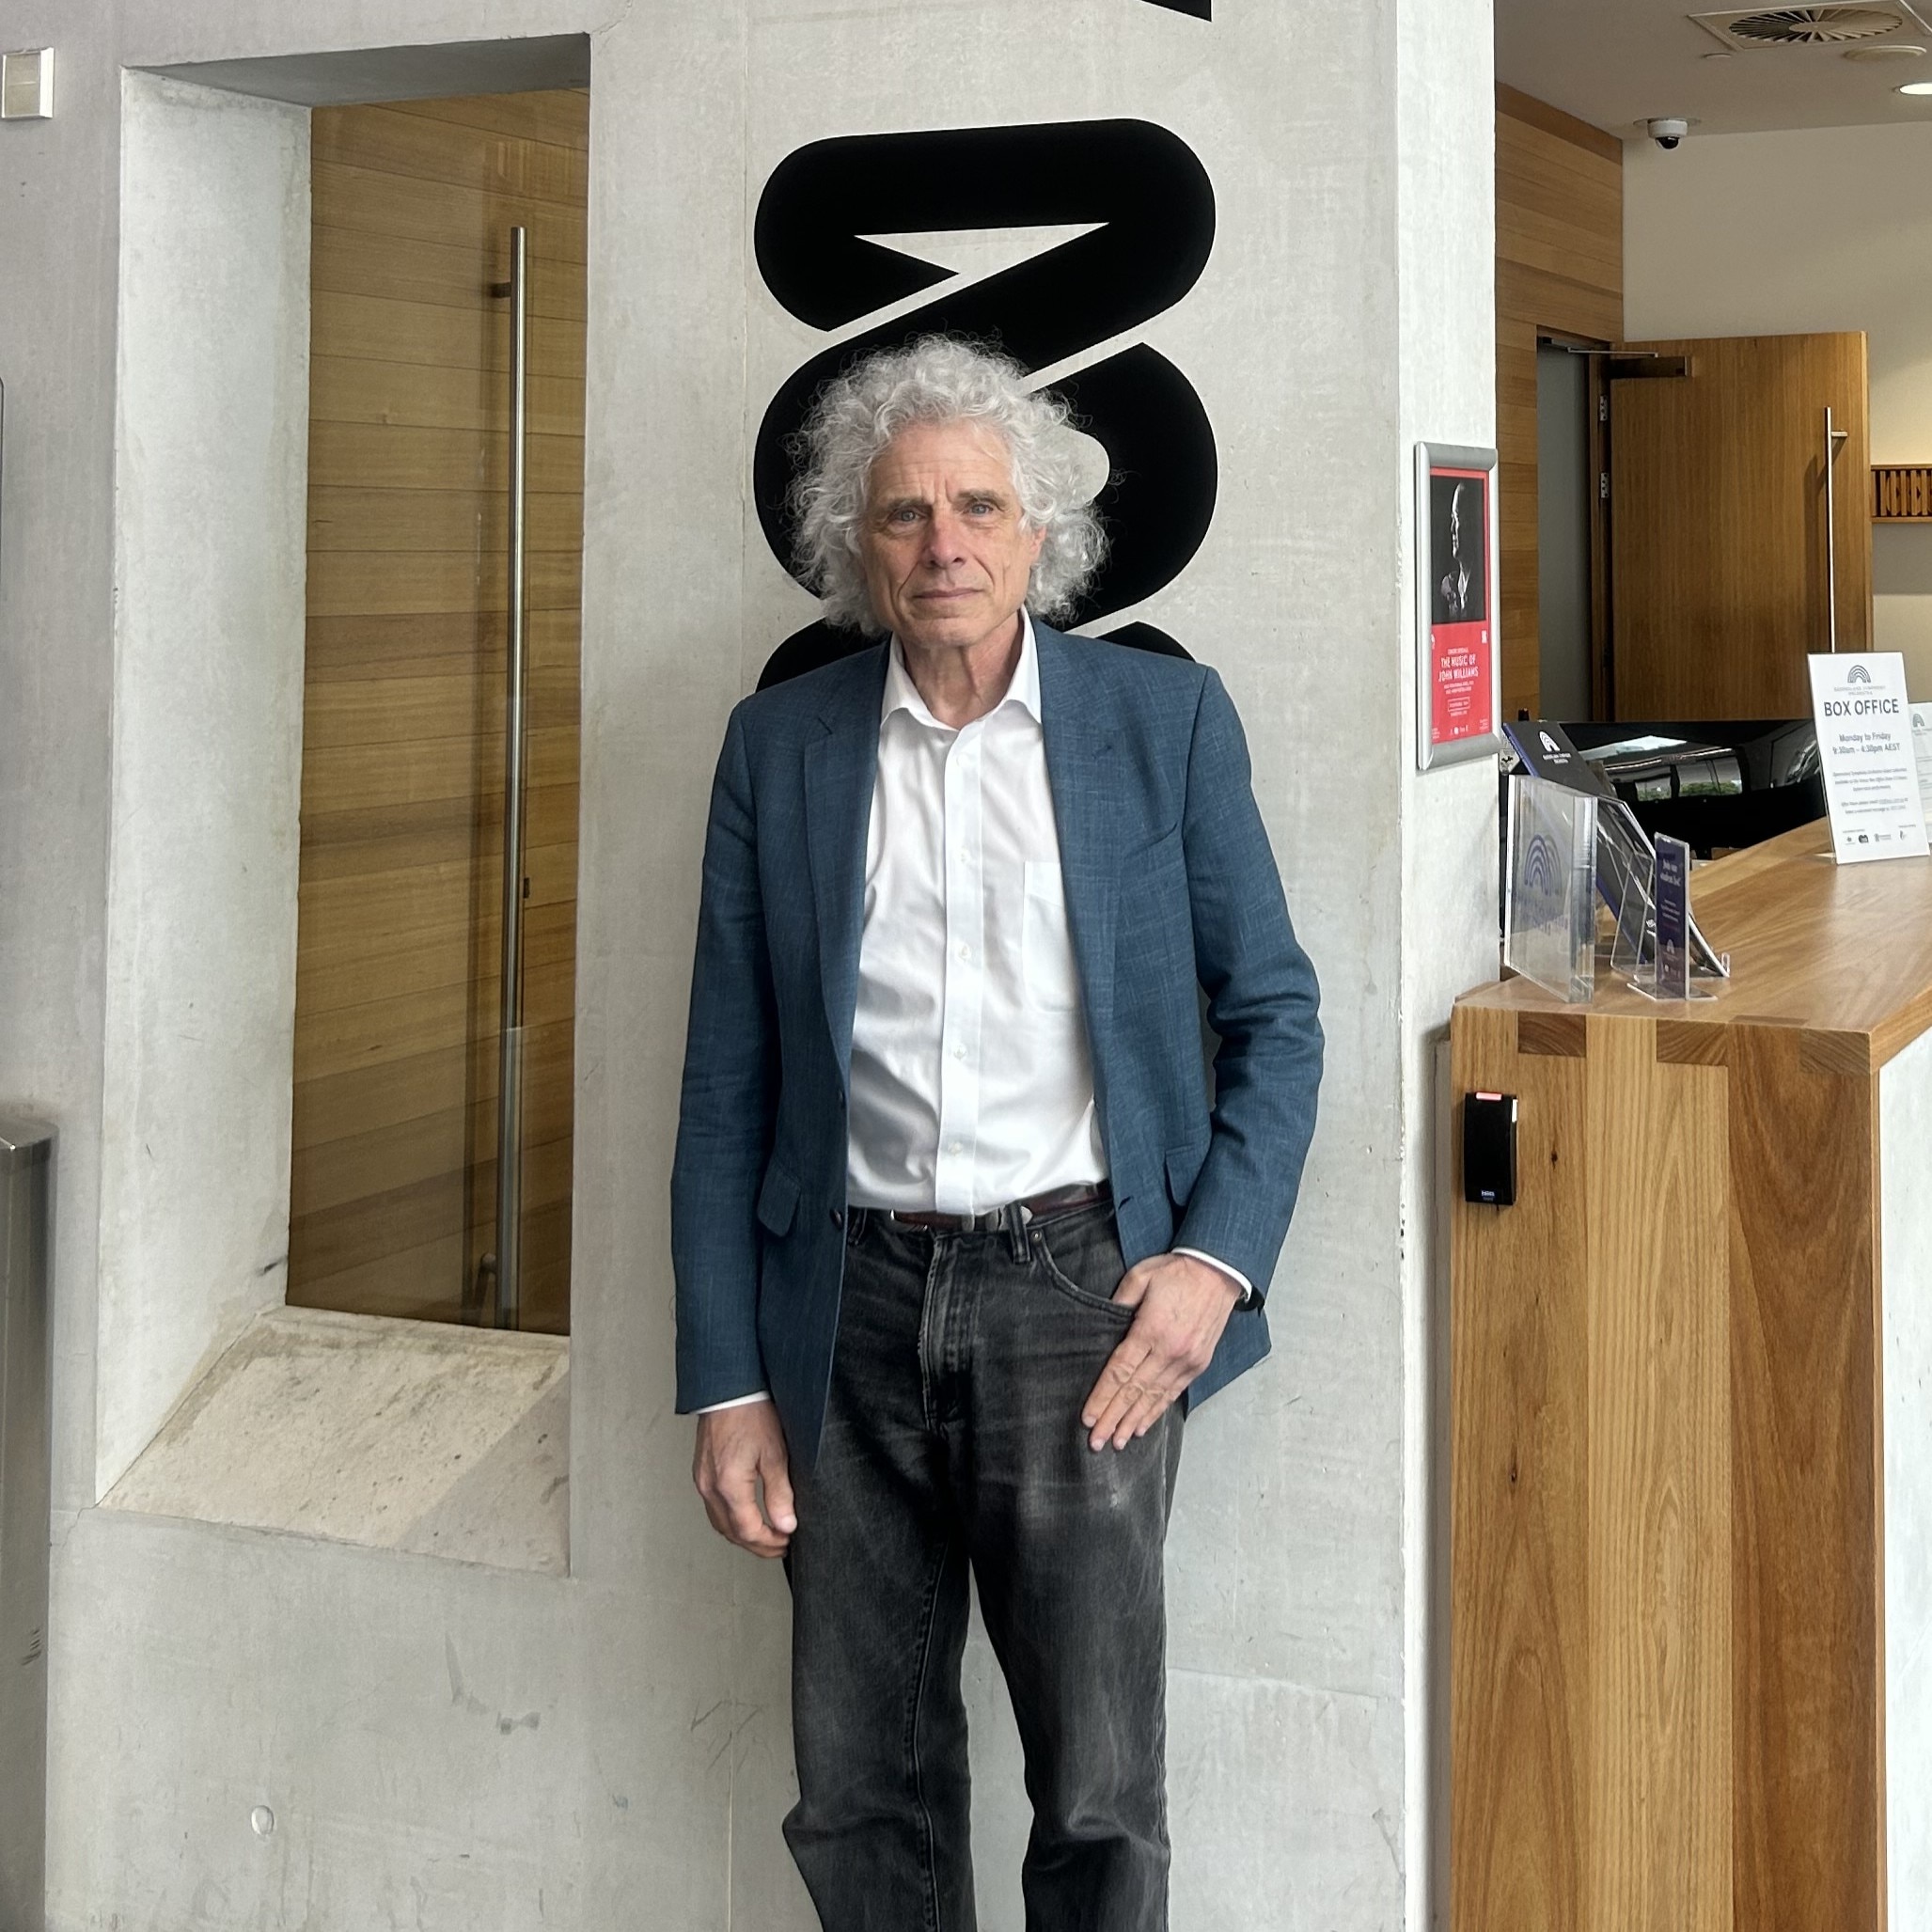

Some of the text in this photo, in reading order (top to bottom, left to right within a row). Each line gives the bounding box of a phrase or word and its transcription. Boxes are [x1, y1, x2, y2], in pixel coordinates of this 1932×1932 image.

[1440, 653, 1476, 668] THE MUSIC OF
[1438, 666, 1479, 683] JOHN WILLIAMS
[1824, 698, 1899, 716] BOX OFFICE
[1839, 731, 1891, 744] Monday to Friday
[1885, 742, 1900, 751] AEST
